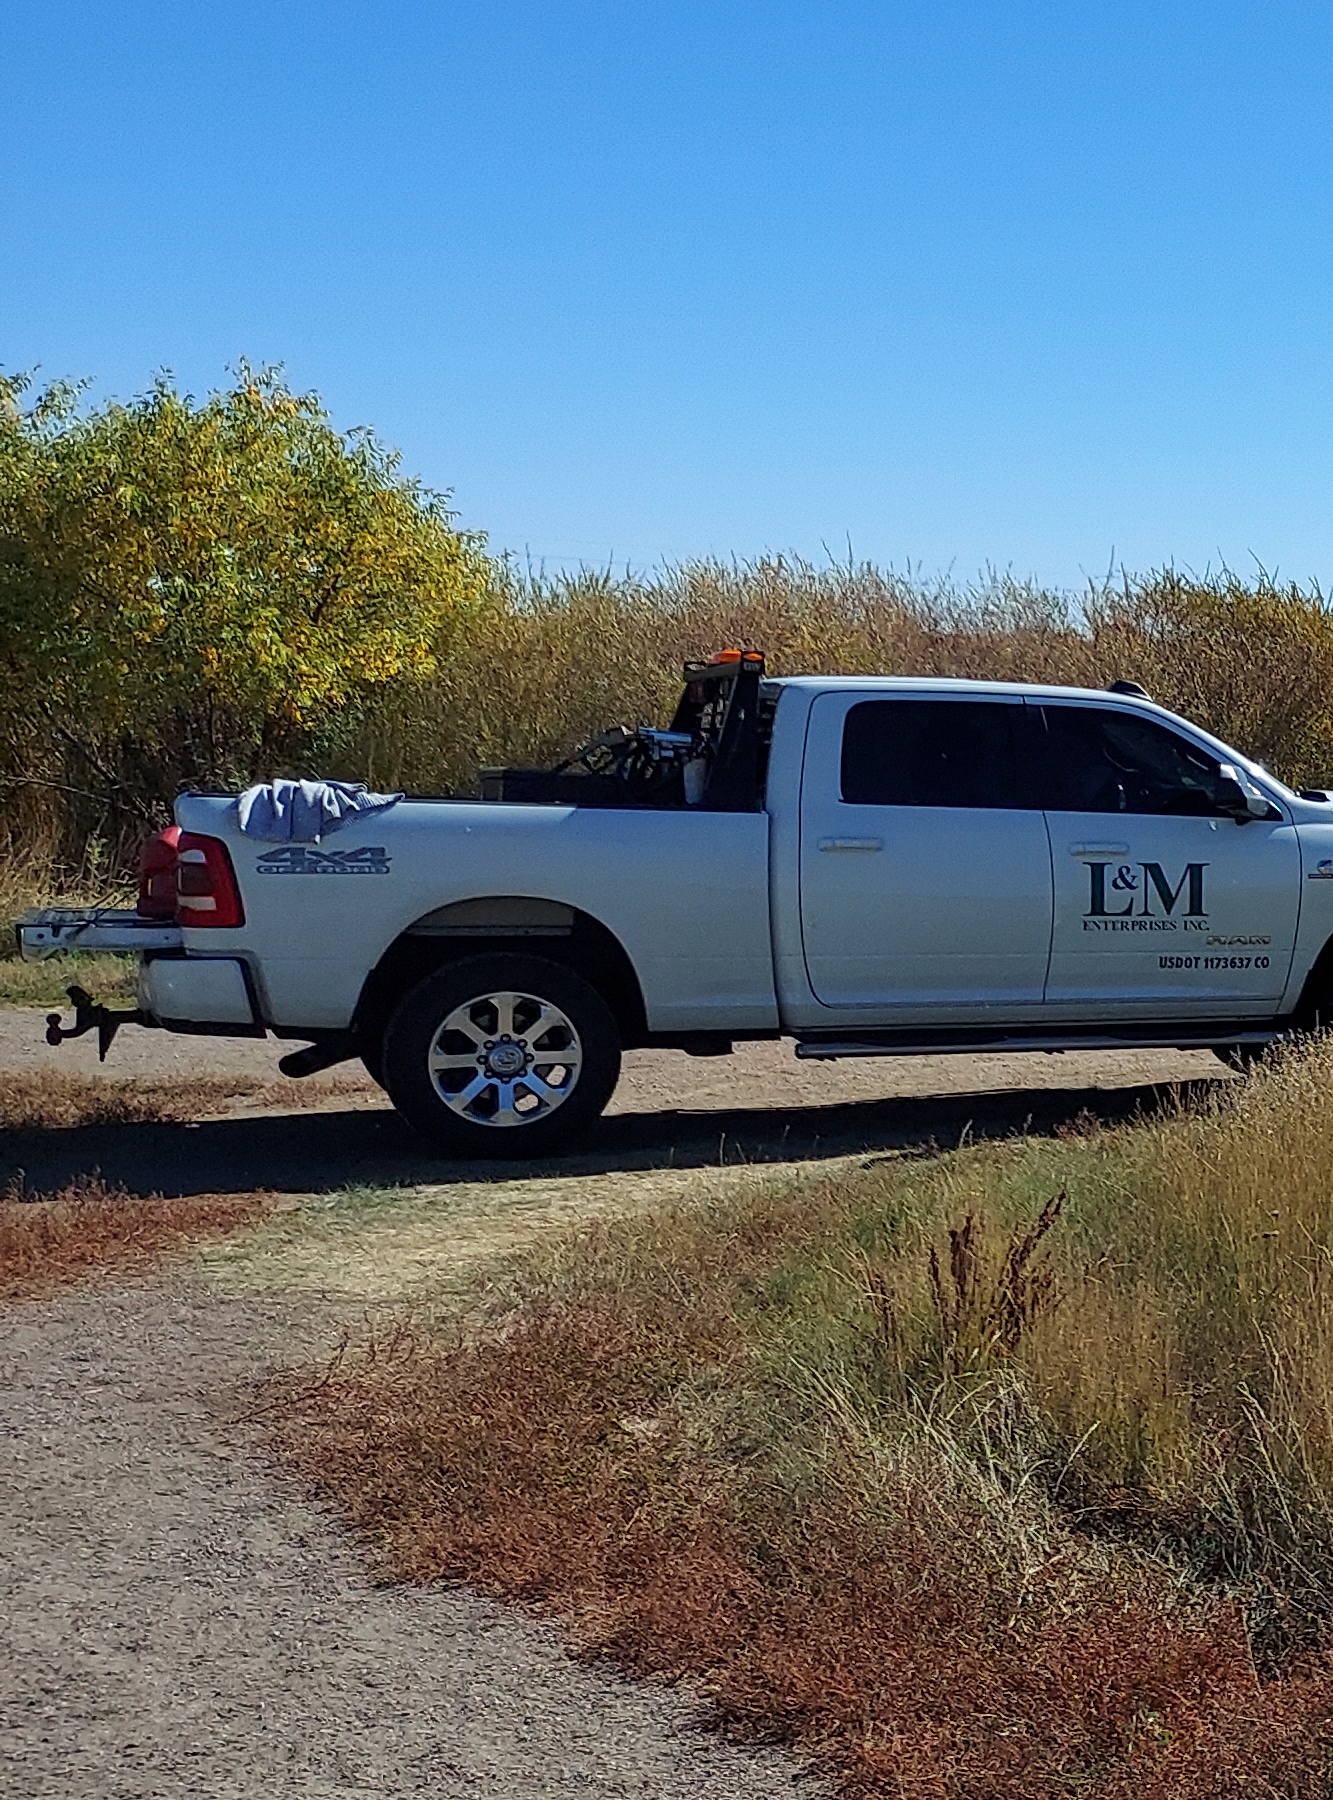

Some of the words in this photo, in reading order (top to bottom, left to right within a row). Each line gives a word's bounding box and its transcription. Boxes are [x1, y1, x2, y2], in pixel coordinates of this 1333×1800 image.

[1082, 862, 1210, 917] L&M
[1083, 920, 1178, 931] ENTERPRISES
[1183, 920, 1210, 931] INC.
[1159, 956, 1200, 969] USDOT
[1204, 957, 1252, 969] 1173637
[1254, 956, 1270, 968] CO
